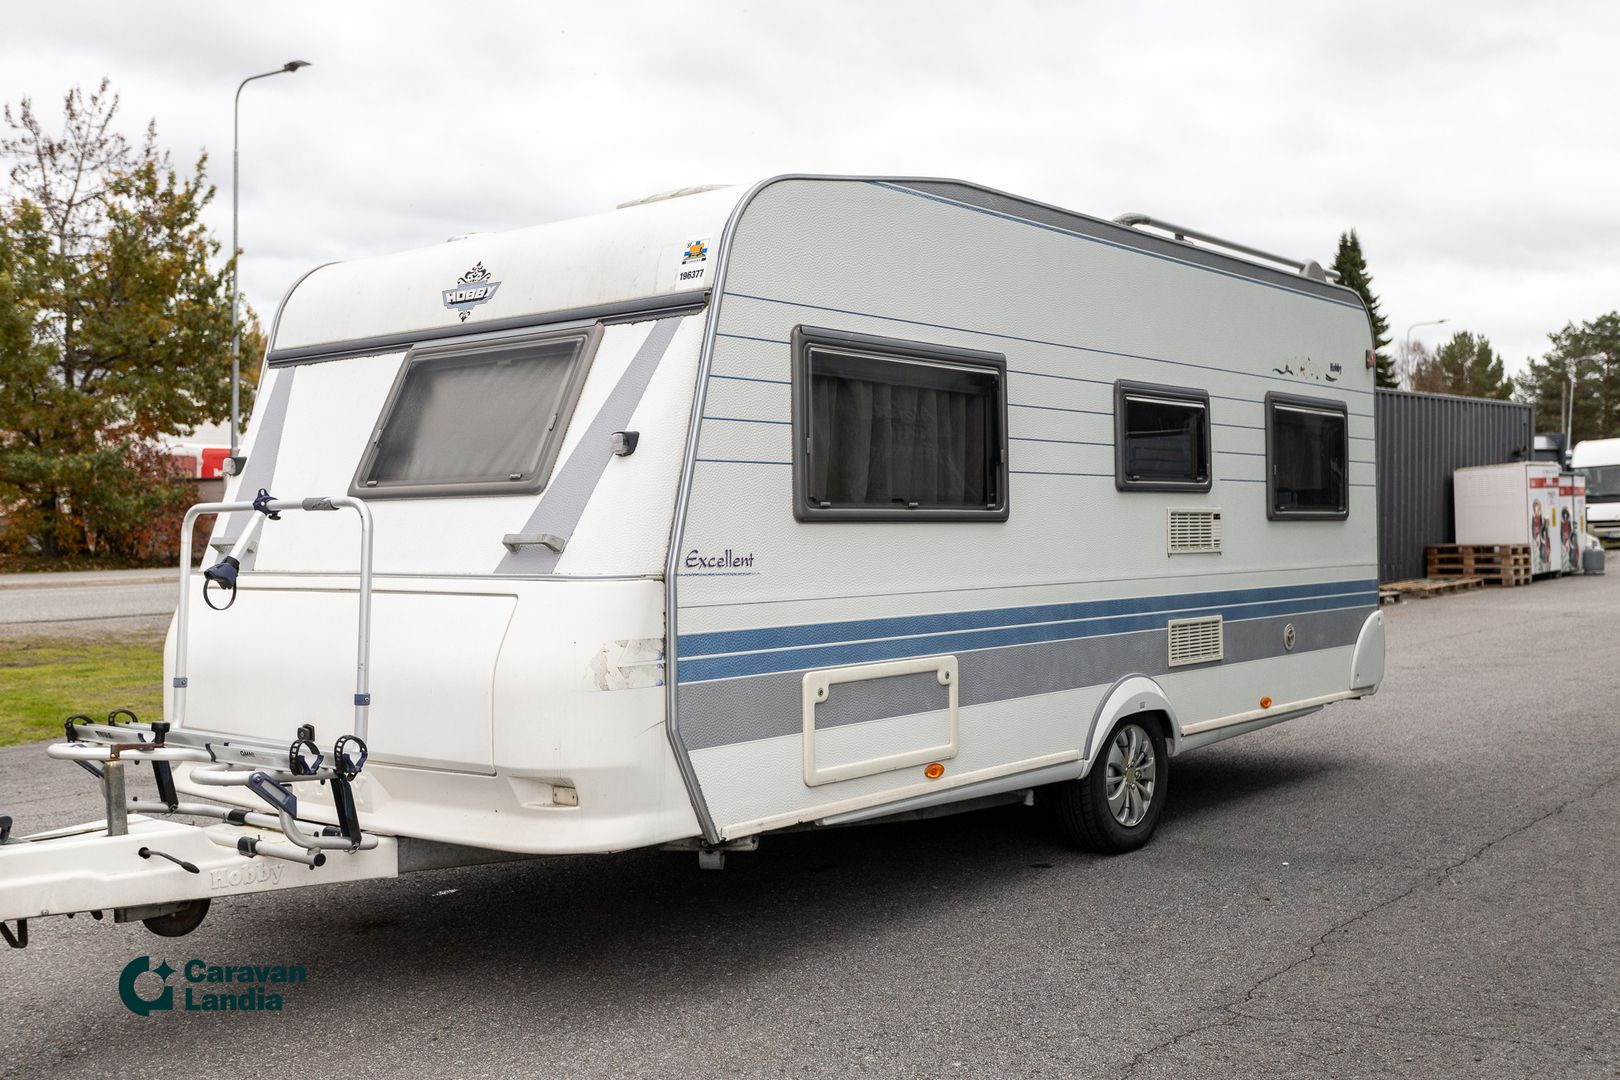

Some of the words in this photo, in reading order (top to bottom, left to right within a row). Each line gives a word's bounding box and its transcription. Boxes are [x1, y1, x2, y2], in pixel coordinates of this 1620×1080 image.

[680, 269, 704, 280] 196377
[446, 284, 498, 304] HOBBY
[685, 549, 754, 569] Excellent
[209, 862, 285, 889] Hobby
